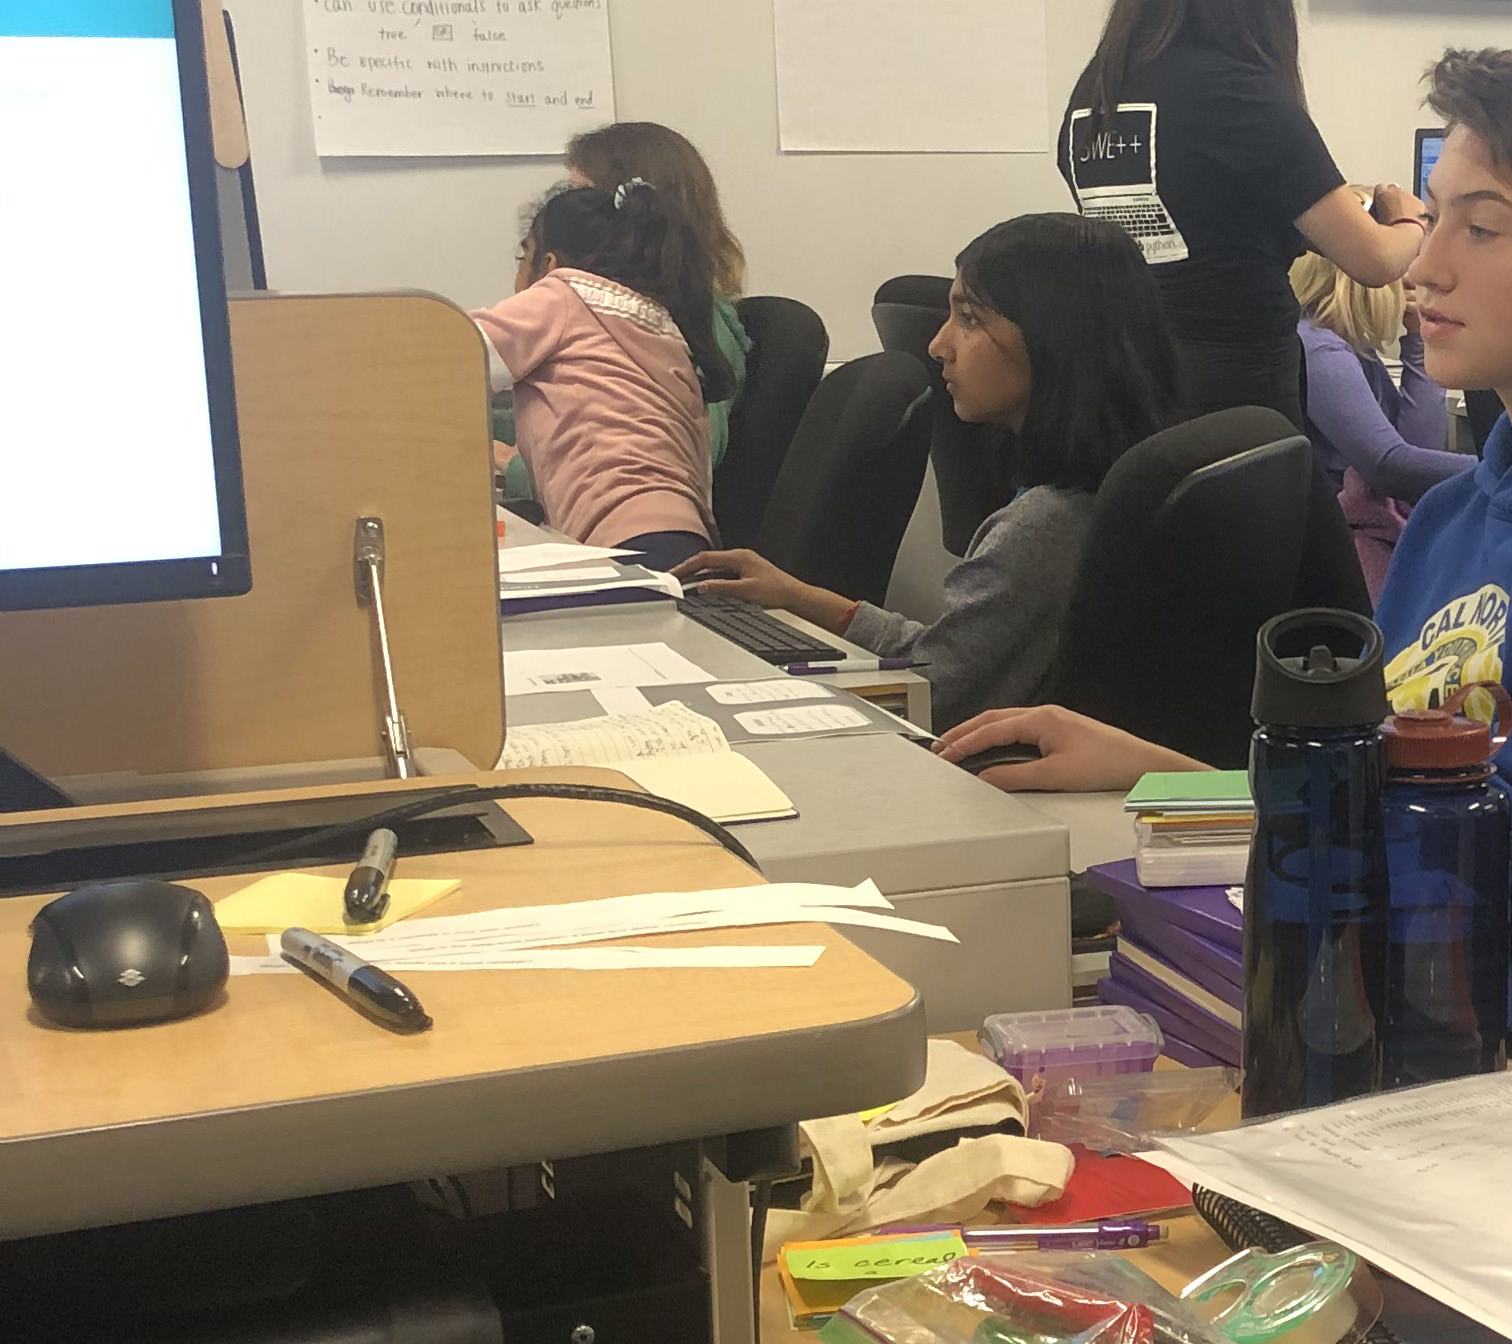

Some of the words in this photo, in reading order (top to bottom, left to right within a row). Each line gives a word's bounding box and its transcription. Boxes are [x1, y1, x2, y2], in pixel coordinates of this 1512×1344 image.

[496, 0, 509, 13] to
[427, 57, 457, 73] with
[467, 59, 545, 74] instructions
[435, 87, 473, 102] where
[545, 92, 568, 106] and
[575, 91, 594, 106] end
[1421, 601, 1468, 651] CAL
